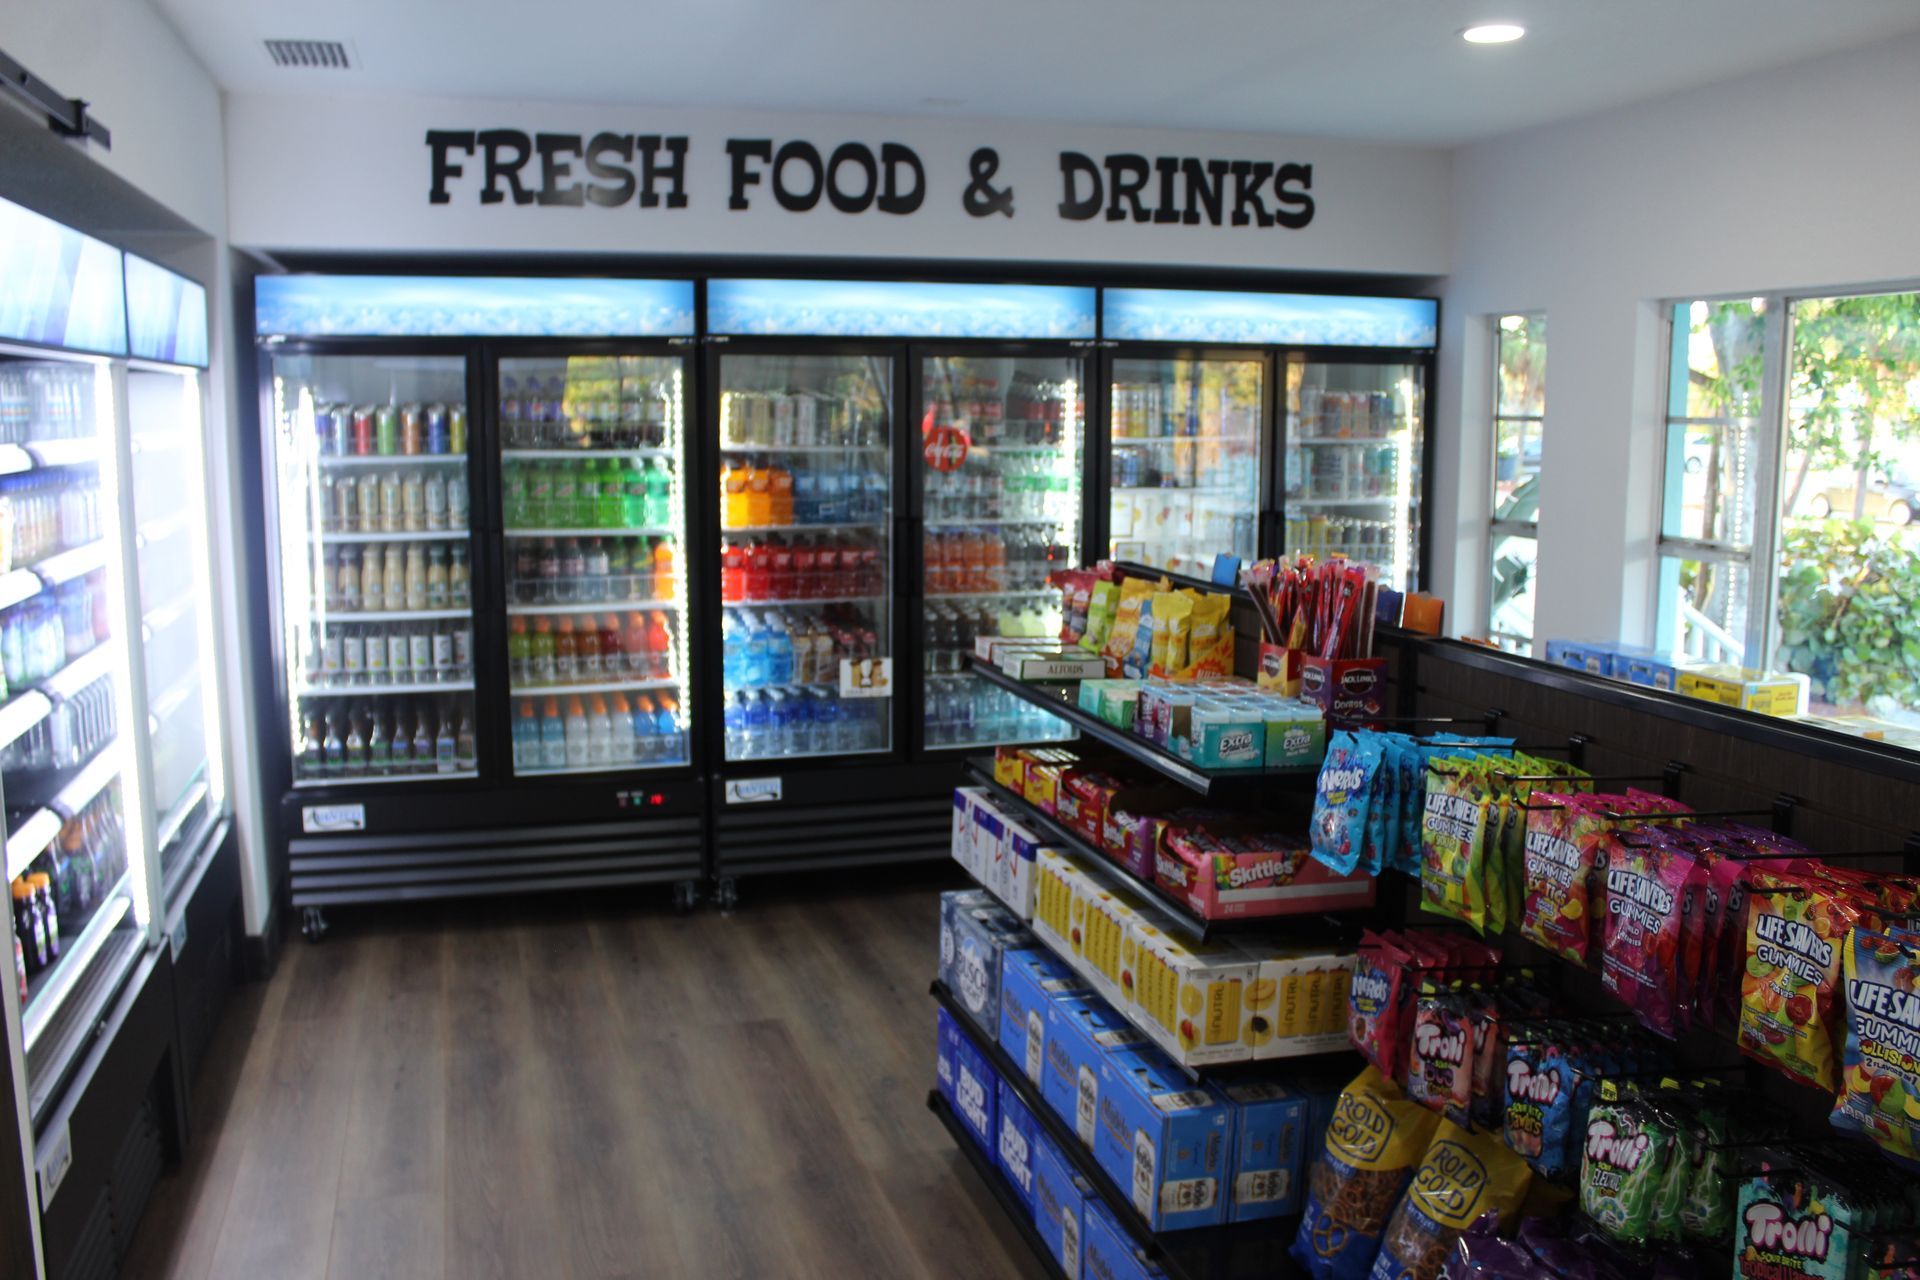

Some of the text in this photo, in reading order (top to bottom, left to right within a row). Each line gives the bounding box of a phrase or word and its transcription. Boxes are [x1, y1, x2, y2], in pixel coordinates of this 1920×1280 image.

[425, 129, 1315, 230] FRESH FOOD & DRINKS
[1220, 733, 1253, 751] Extra
[1229, 859, 1294, 888] Skittles
[1527, 858, 1572, 888] GUMMIES
[1609, 899, 1661, 935] GUMMIES
[1756, 944, 1824, 986] GUMMIES
[1781, 975, 1790, 986] 5
[1415, 1023, 1466, 1065] Trolli
[1866, 1057, 1873, 1067] 2
[1341, 1091, 1385, 1134] ROLD
[1331, 1116, 1377, 1155] GOLD
[1587, 1120, 1649, 1173] Trolli
[1417, 1165, 1465, 1211] GOLD
[1432, 1147, 1481, 1188] ROLD
[1745, 1202, 1832, 1260] Trolli
